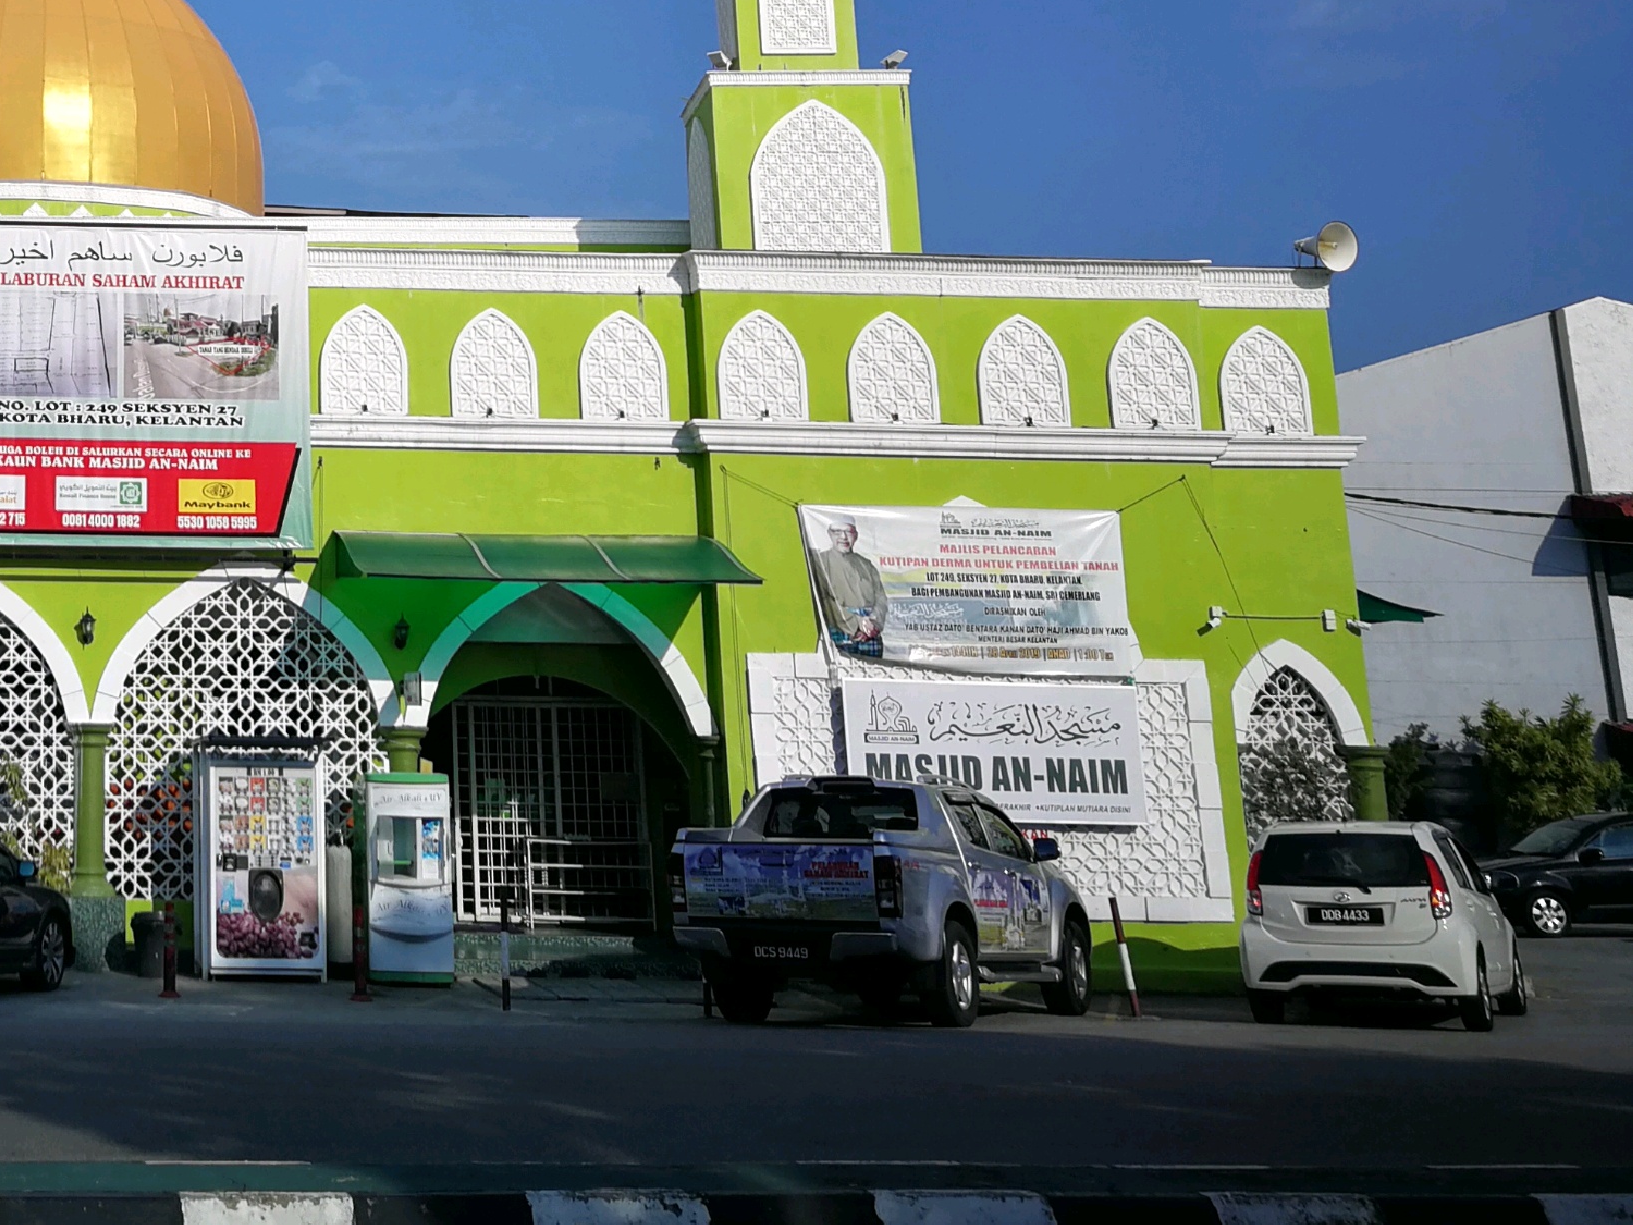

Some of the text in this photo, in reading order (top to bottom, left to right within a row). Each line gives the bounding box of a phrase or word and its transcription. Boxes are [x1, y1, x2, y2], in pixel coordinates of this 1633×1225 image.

[93, 273, 157, 288] SAHAM
[161, 274, 245, 289] AKHIRAT
[35, 401, 72, 412] LOT
[86, 403, 117, 413] 249
[122, 403, 211, 414] SEKSYEN
[217, 405, 238, 416] 27
[57, 413, 131, 427] BHARU,
[136, 415, 244, 426] KELANTAN
[25, 445, 63, 455] BOLEH
[66, 446, 79, 456] DI
[82, 447, 142, 457] SALURKAN
[144, 448, 188, 458] SECARA
[191, 448, 232, 458] ONLINE
[235, 449, 251, 458] KE
[41, 456, 85, 468] BANK
[88, 457, 146, 469] MASJID
[149, 458, 218, 471] AN-NAIM
[184, 501, 251, 510] Maybank
[88, 514, 115, 528] 4000
[178, 515, 204, 529] 5530
[231, 516, 257, 529] 5995
[994, 529, 1052, 537] AN-NAIM
[940, 544, 1057, 555] MAJLIS PELANCARAN
[879, 556, 1119, 571] KUTIPAN DERMA UNTUK PEMBELIAN TANAH
[930, 588, 984, 598] PEMBANGUNAN
[984, 590, 1011, 598] MASJID
[1029, 608, 1046, 616] OLEH
[866, 752, 1129, 794] MASJID AN-NAIM
[1321, 909, 1342, 921] DDB
